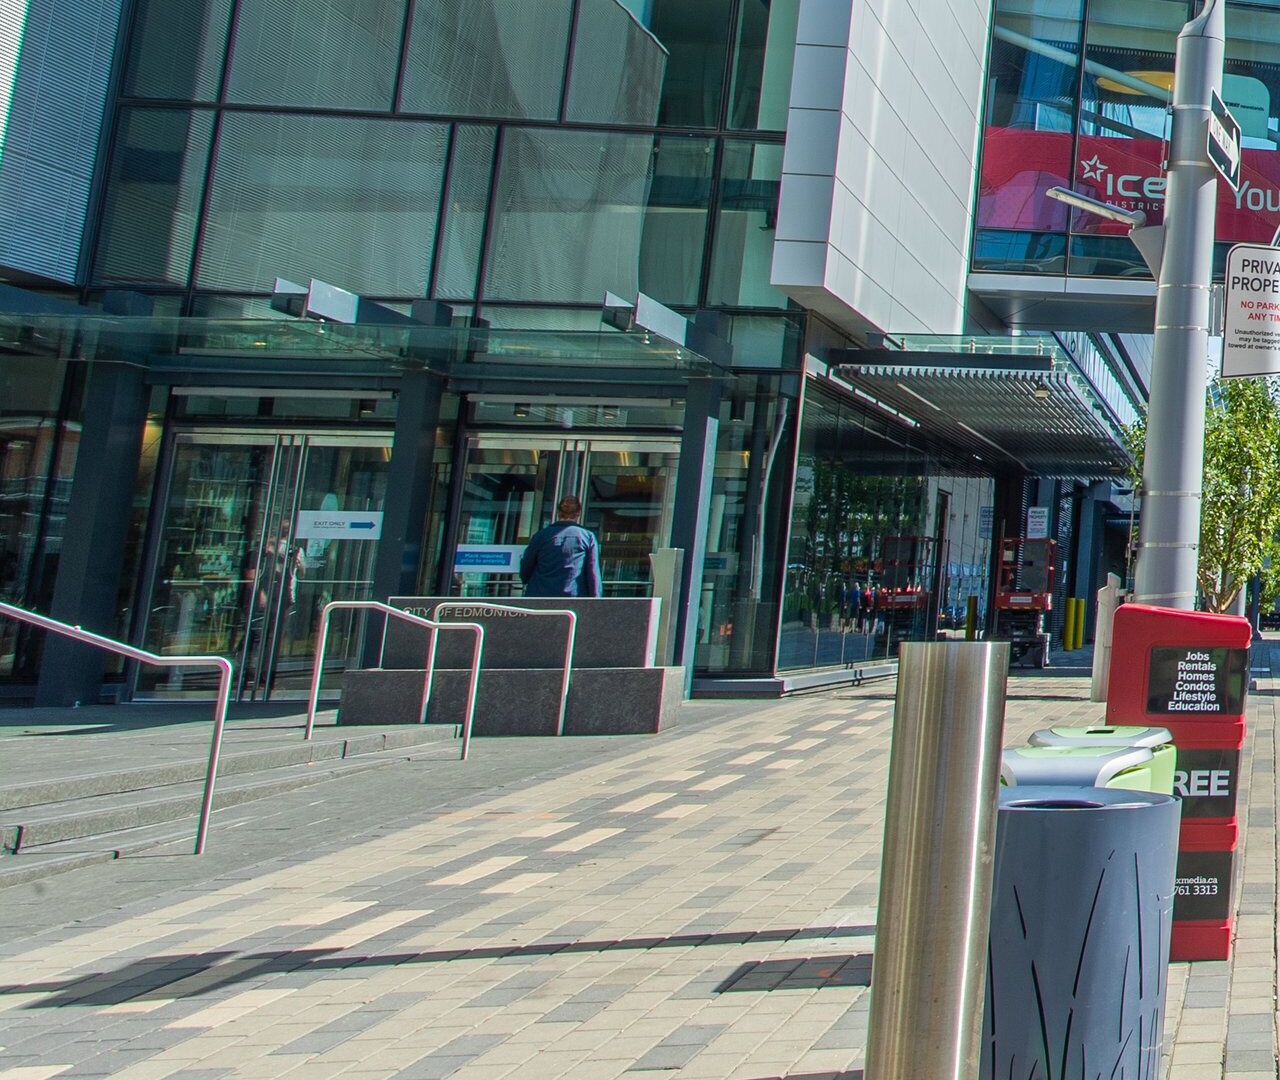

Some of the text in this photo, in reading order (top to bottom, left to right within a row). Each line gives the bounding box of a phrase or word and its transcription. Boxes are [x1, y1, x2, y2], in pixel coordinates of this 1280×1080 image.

[1240, 300, 1255, 309] NO
[1247, 313, 1267, 321] ANY
[1234, 328, 1274, 337] Unauthorized
[403, 607, 528, 618] CITY OF EDMONTON
[1185, 651, 1210, 661] Jobs
[1177, 661, 1217, 671] Rentals
[1177, 671, 1215, 681] Homes
[1175, 681, 1216, 691] Condos
[1173, 691, 1217, 703] Lifestyle
[1167, 701, 1220, 712] Education
[1173, 770, 1230, 796] REE
[1175, 875, 1218, 885] xmedia.ca
[1192, 885, 1218, 895] 3313
